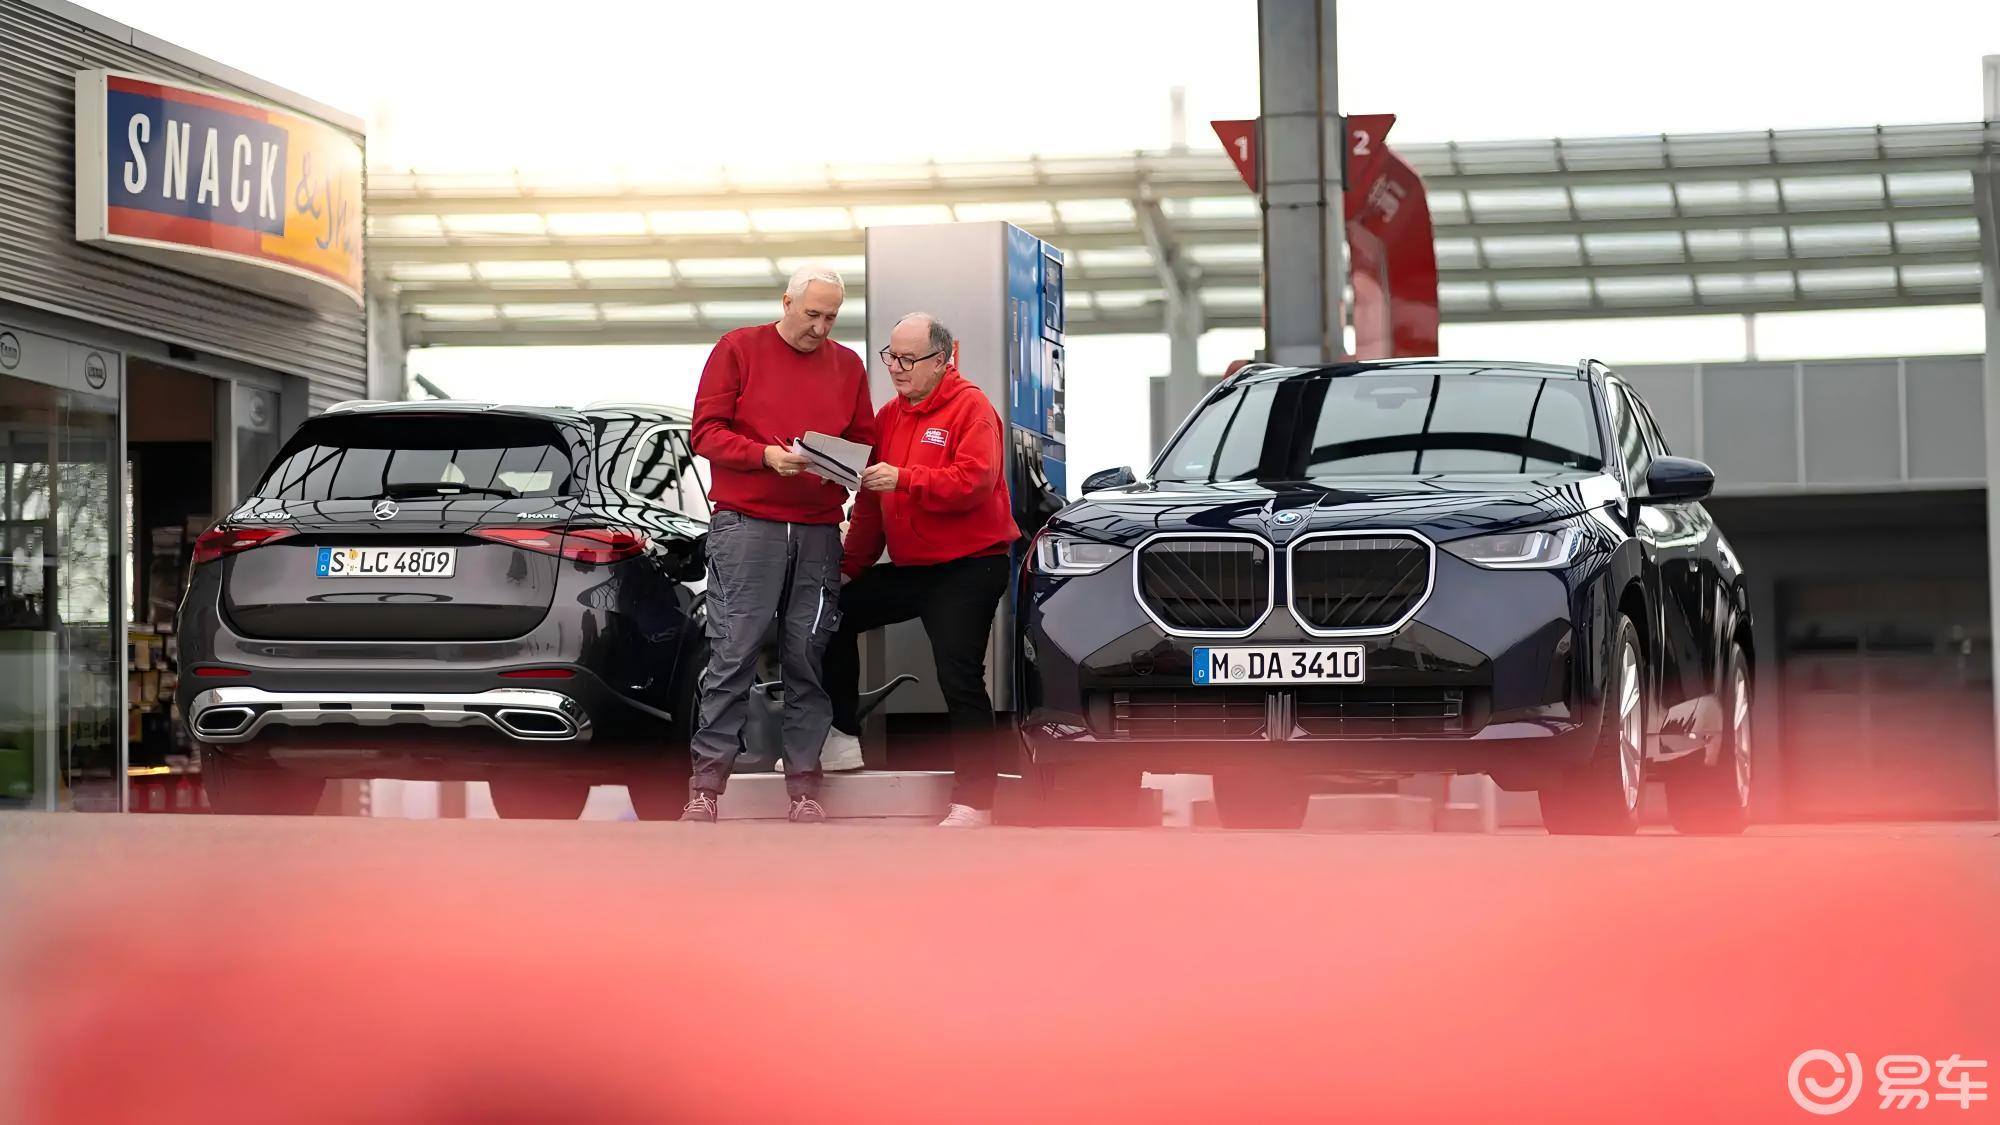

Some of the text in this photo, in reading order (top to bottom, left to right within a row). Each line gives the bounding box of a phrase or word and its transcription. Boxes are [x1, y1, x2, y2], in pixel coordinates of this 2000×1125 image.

[1234, 136, 1248, 162] 1
[1353, 130, 1371, 156] 2
[124, 113, 279, 221] SNACK
[296, 152, 321, 219] &
[331, 552, 450, 573] S LC 4809
[1212, 651, 1360, 679] M DA 3410
